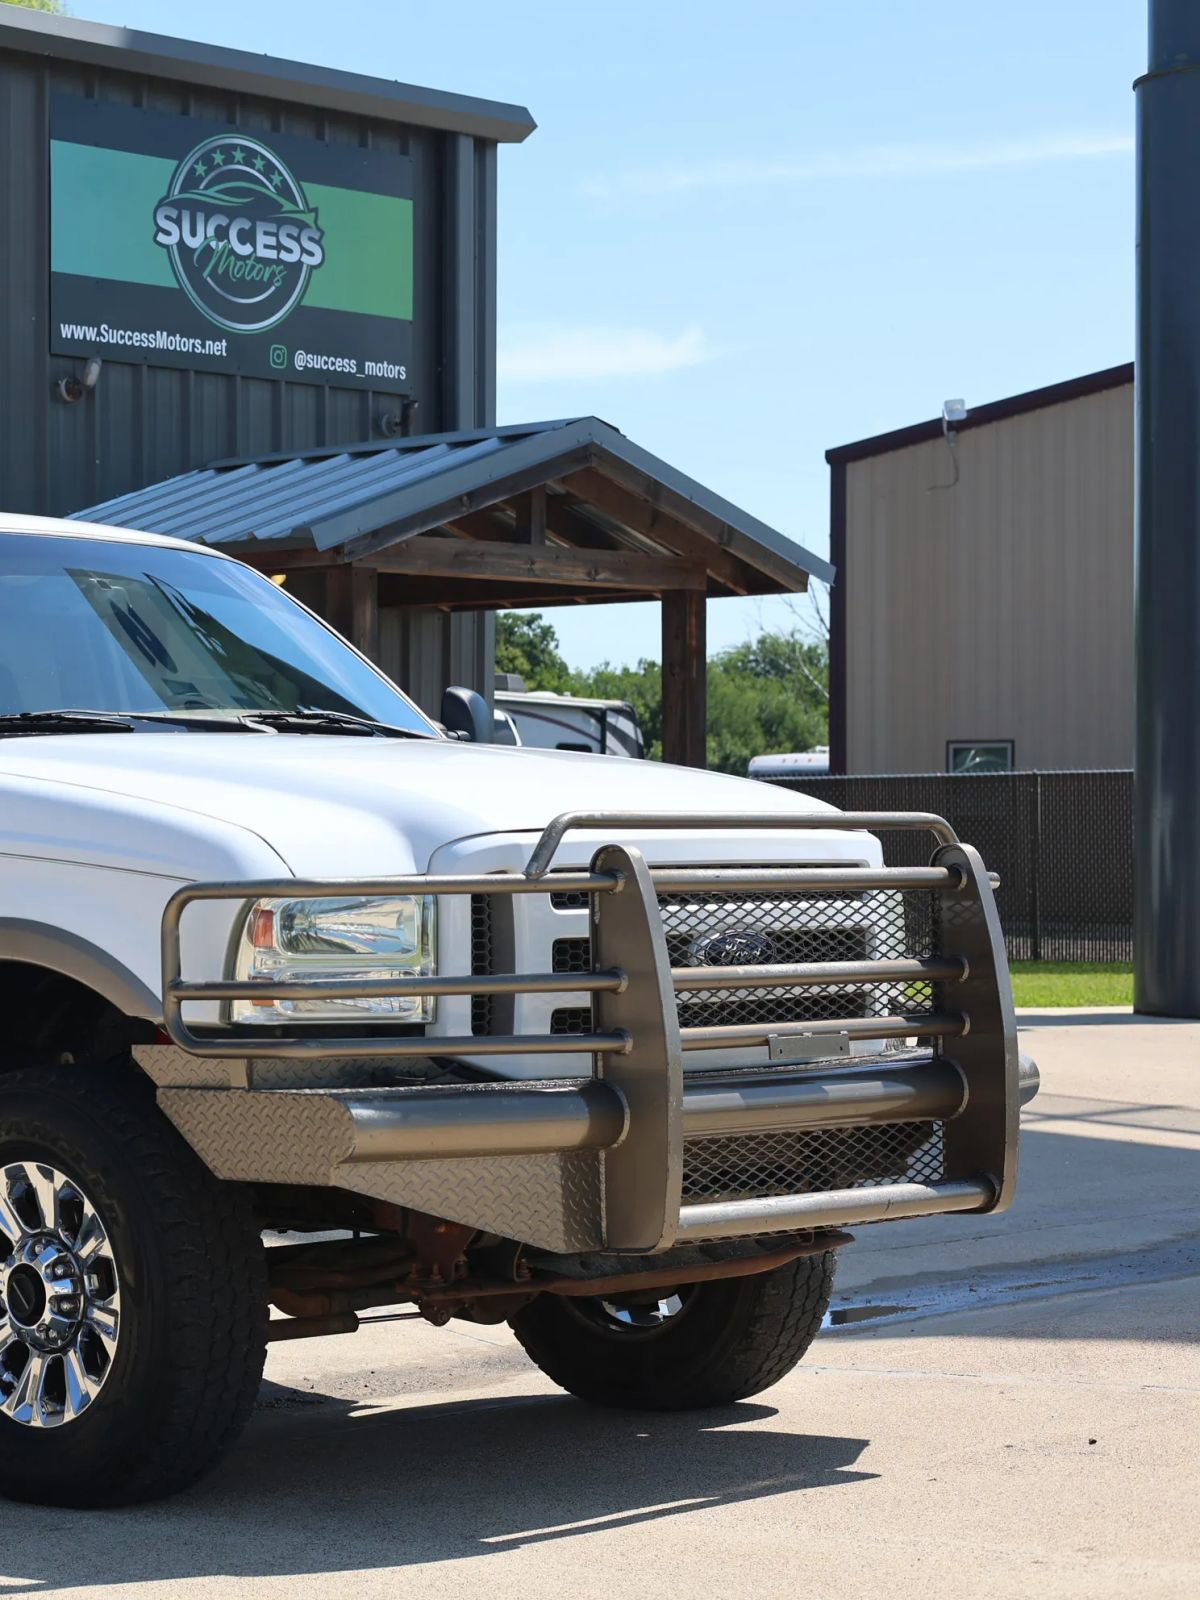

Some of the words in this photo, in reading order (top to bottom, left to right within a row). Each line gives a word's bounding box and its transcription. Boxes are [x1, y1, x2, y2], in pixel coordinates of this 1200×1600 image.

[156, 206, 322, 266] SUCCESS
[194, 236, 287, 287] Motors
[60, 323, 227, 356] www.SuccessMotors.net
[294, 350, 406, 380] @success_motors
